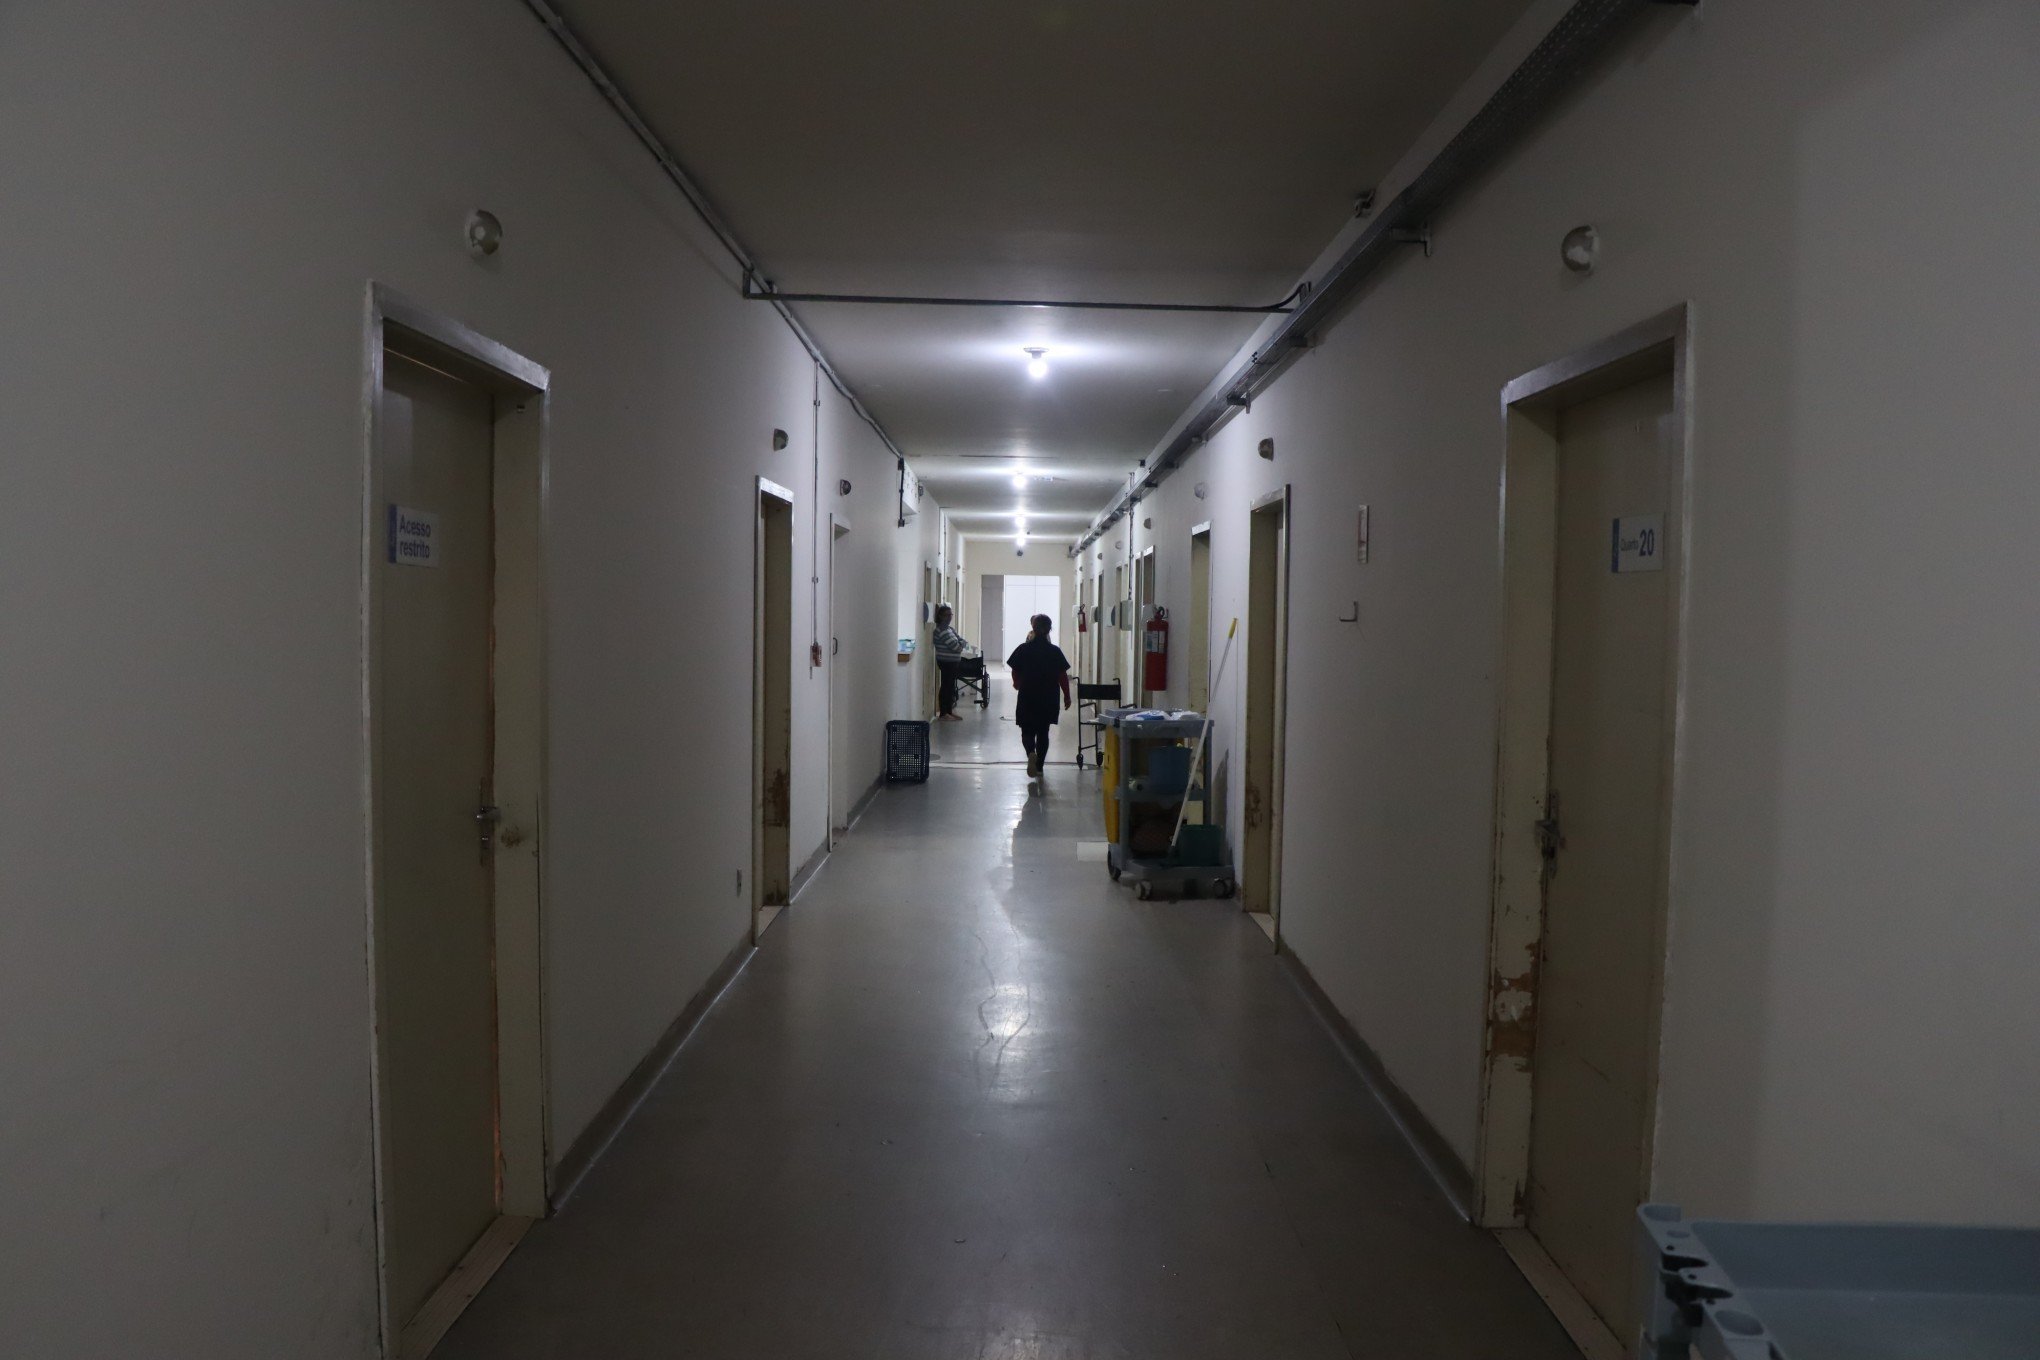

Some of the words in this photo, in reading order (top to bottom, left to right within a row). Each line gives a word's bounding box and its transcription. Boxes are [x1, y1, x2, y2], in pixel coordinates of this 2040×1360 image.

[399, 514, 431, 537] Acesso
[399, 540, 430, 559] restrito
[1639, 528, 1655, 557] 20
